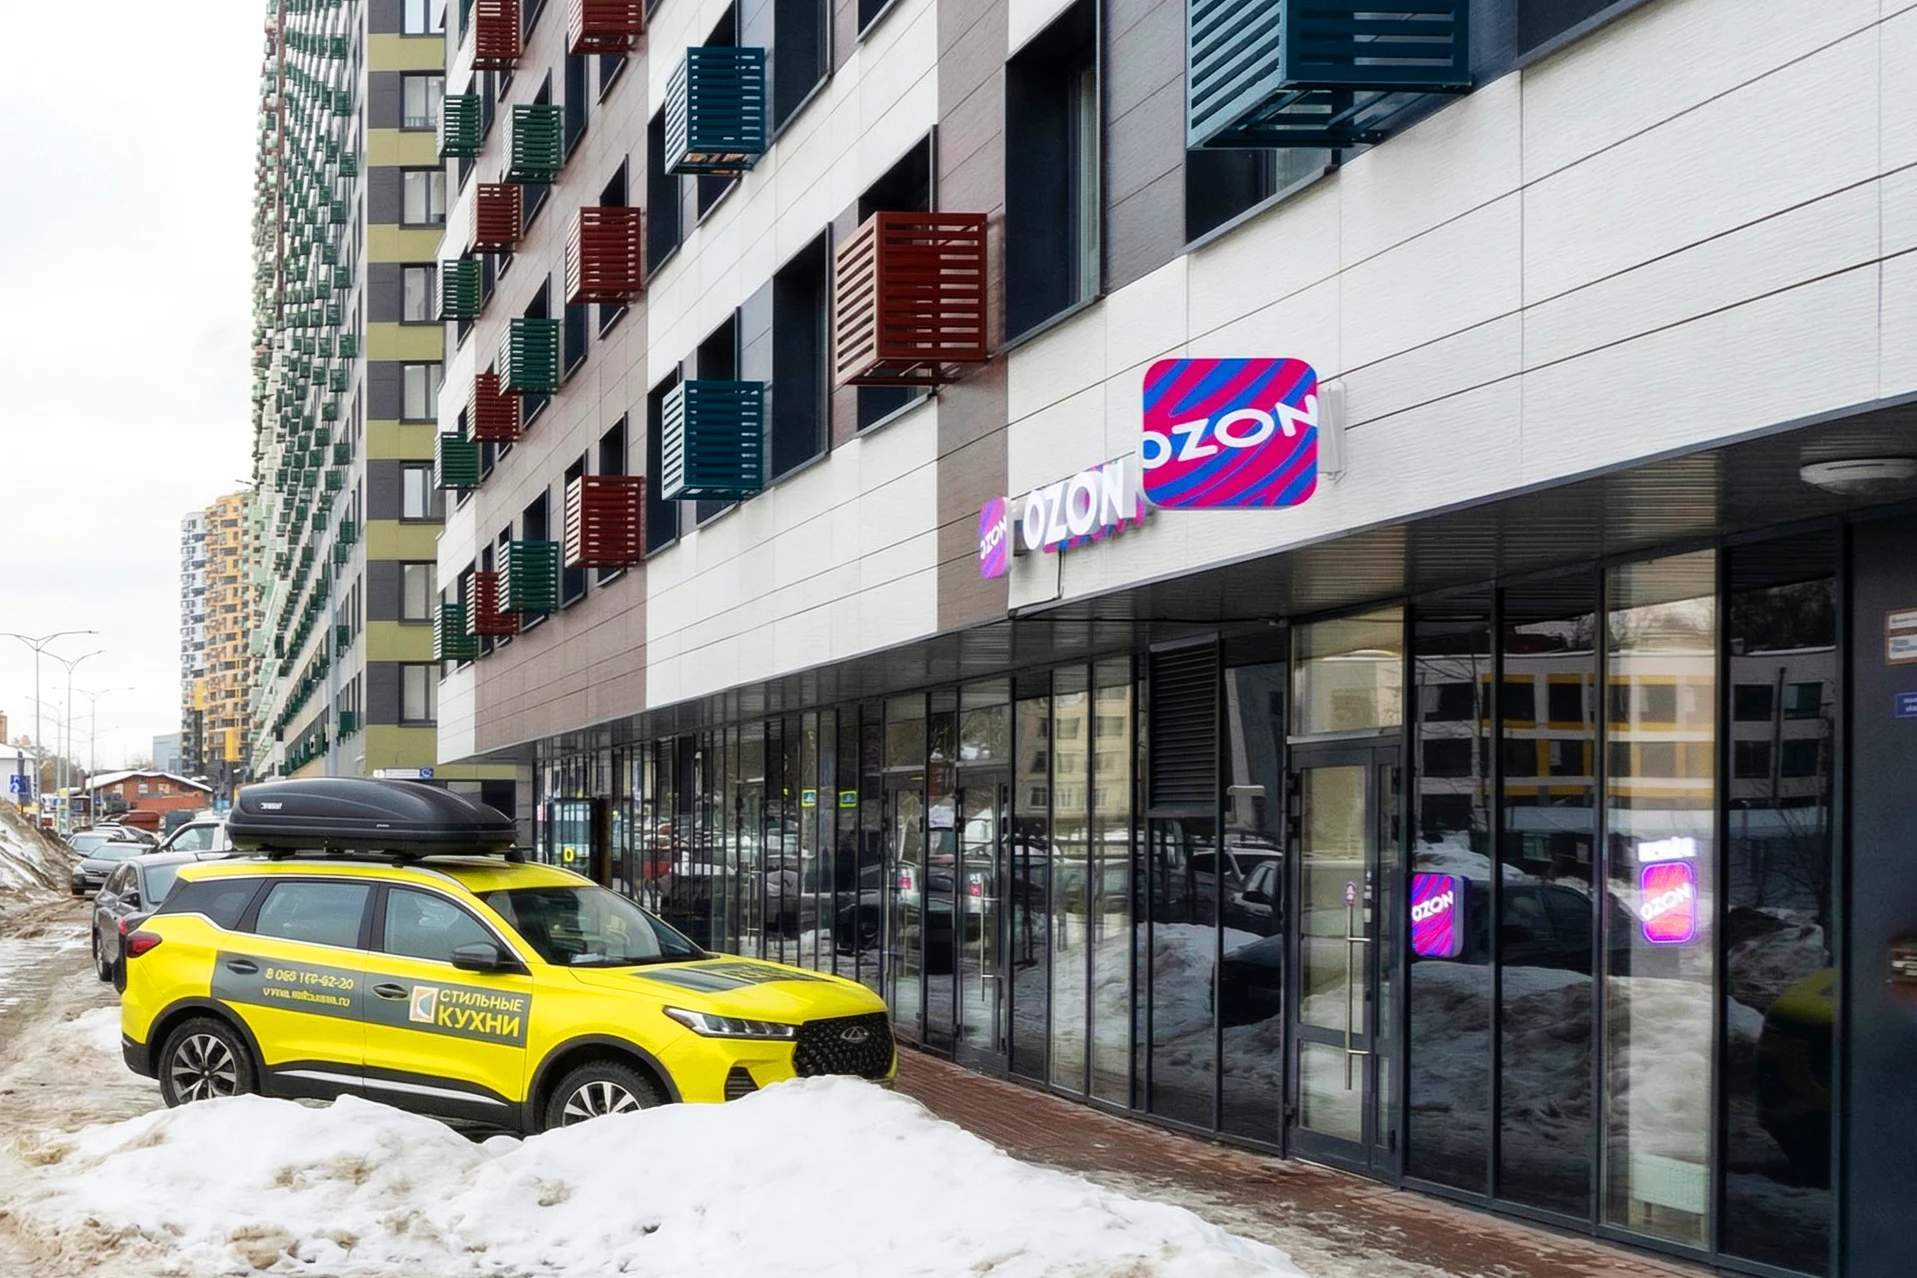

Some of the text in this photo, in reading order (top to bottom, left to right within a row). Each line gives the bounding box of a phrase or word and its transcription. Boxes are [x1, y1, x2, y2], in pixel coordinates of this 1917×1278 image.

[1141, 394, 1319, 470] OZON
[1023, 460, 1130, 551] OZON
[1411, 890, 1454, 922] OZON
[1640, 882, 1692, 922] OZON
[440, 989, 524, 1013] СТИЛЬНЫЕ
[437, 1005, 520, 1038] КУХНИ
